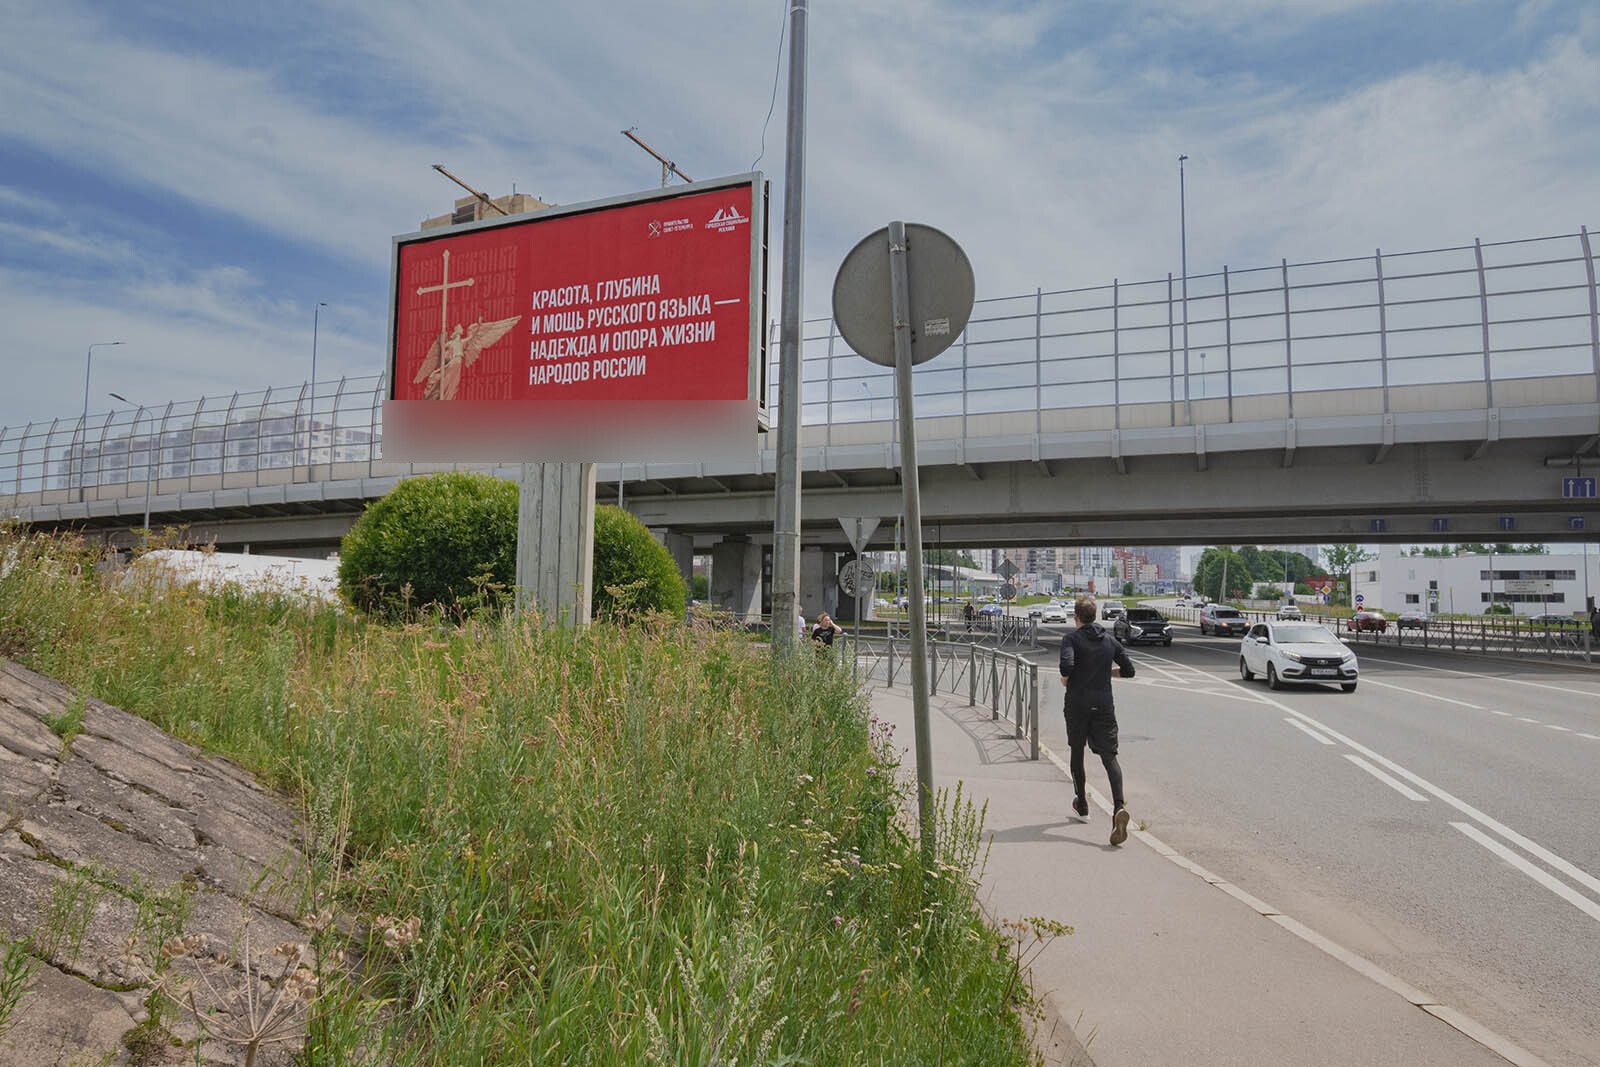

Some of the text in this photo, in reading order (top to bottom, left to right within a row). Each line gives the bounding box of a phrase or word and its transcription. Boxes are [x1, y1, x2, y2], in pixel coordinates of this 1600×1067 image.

[532, 284, 593, 310] КРАСОТА,
[596, 274, 661, 302] ГЛУБИНА
[531, 315, 541, 335] И
[543, 310, 585, 334] МОЩЬ
[587, 300, 656, 329] РУССКОГО
[659, 294, 712, 321] ЯЗЫКА
[530, 334, 598, 361] НАДЕЖДА
[599, 332, 610, 353] И
[612, 327, 658, 352] ОПОРА
[660, 320, 716, 347] ЖИЗНИ
[528, 361, 590, 386] НАРОДОВ
[592, 355, 647, 380] РОССИИ
